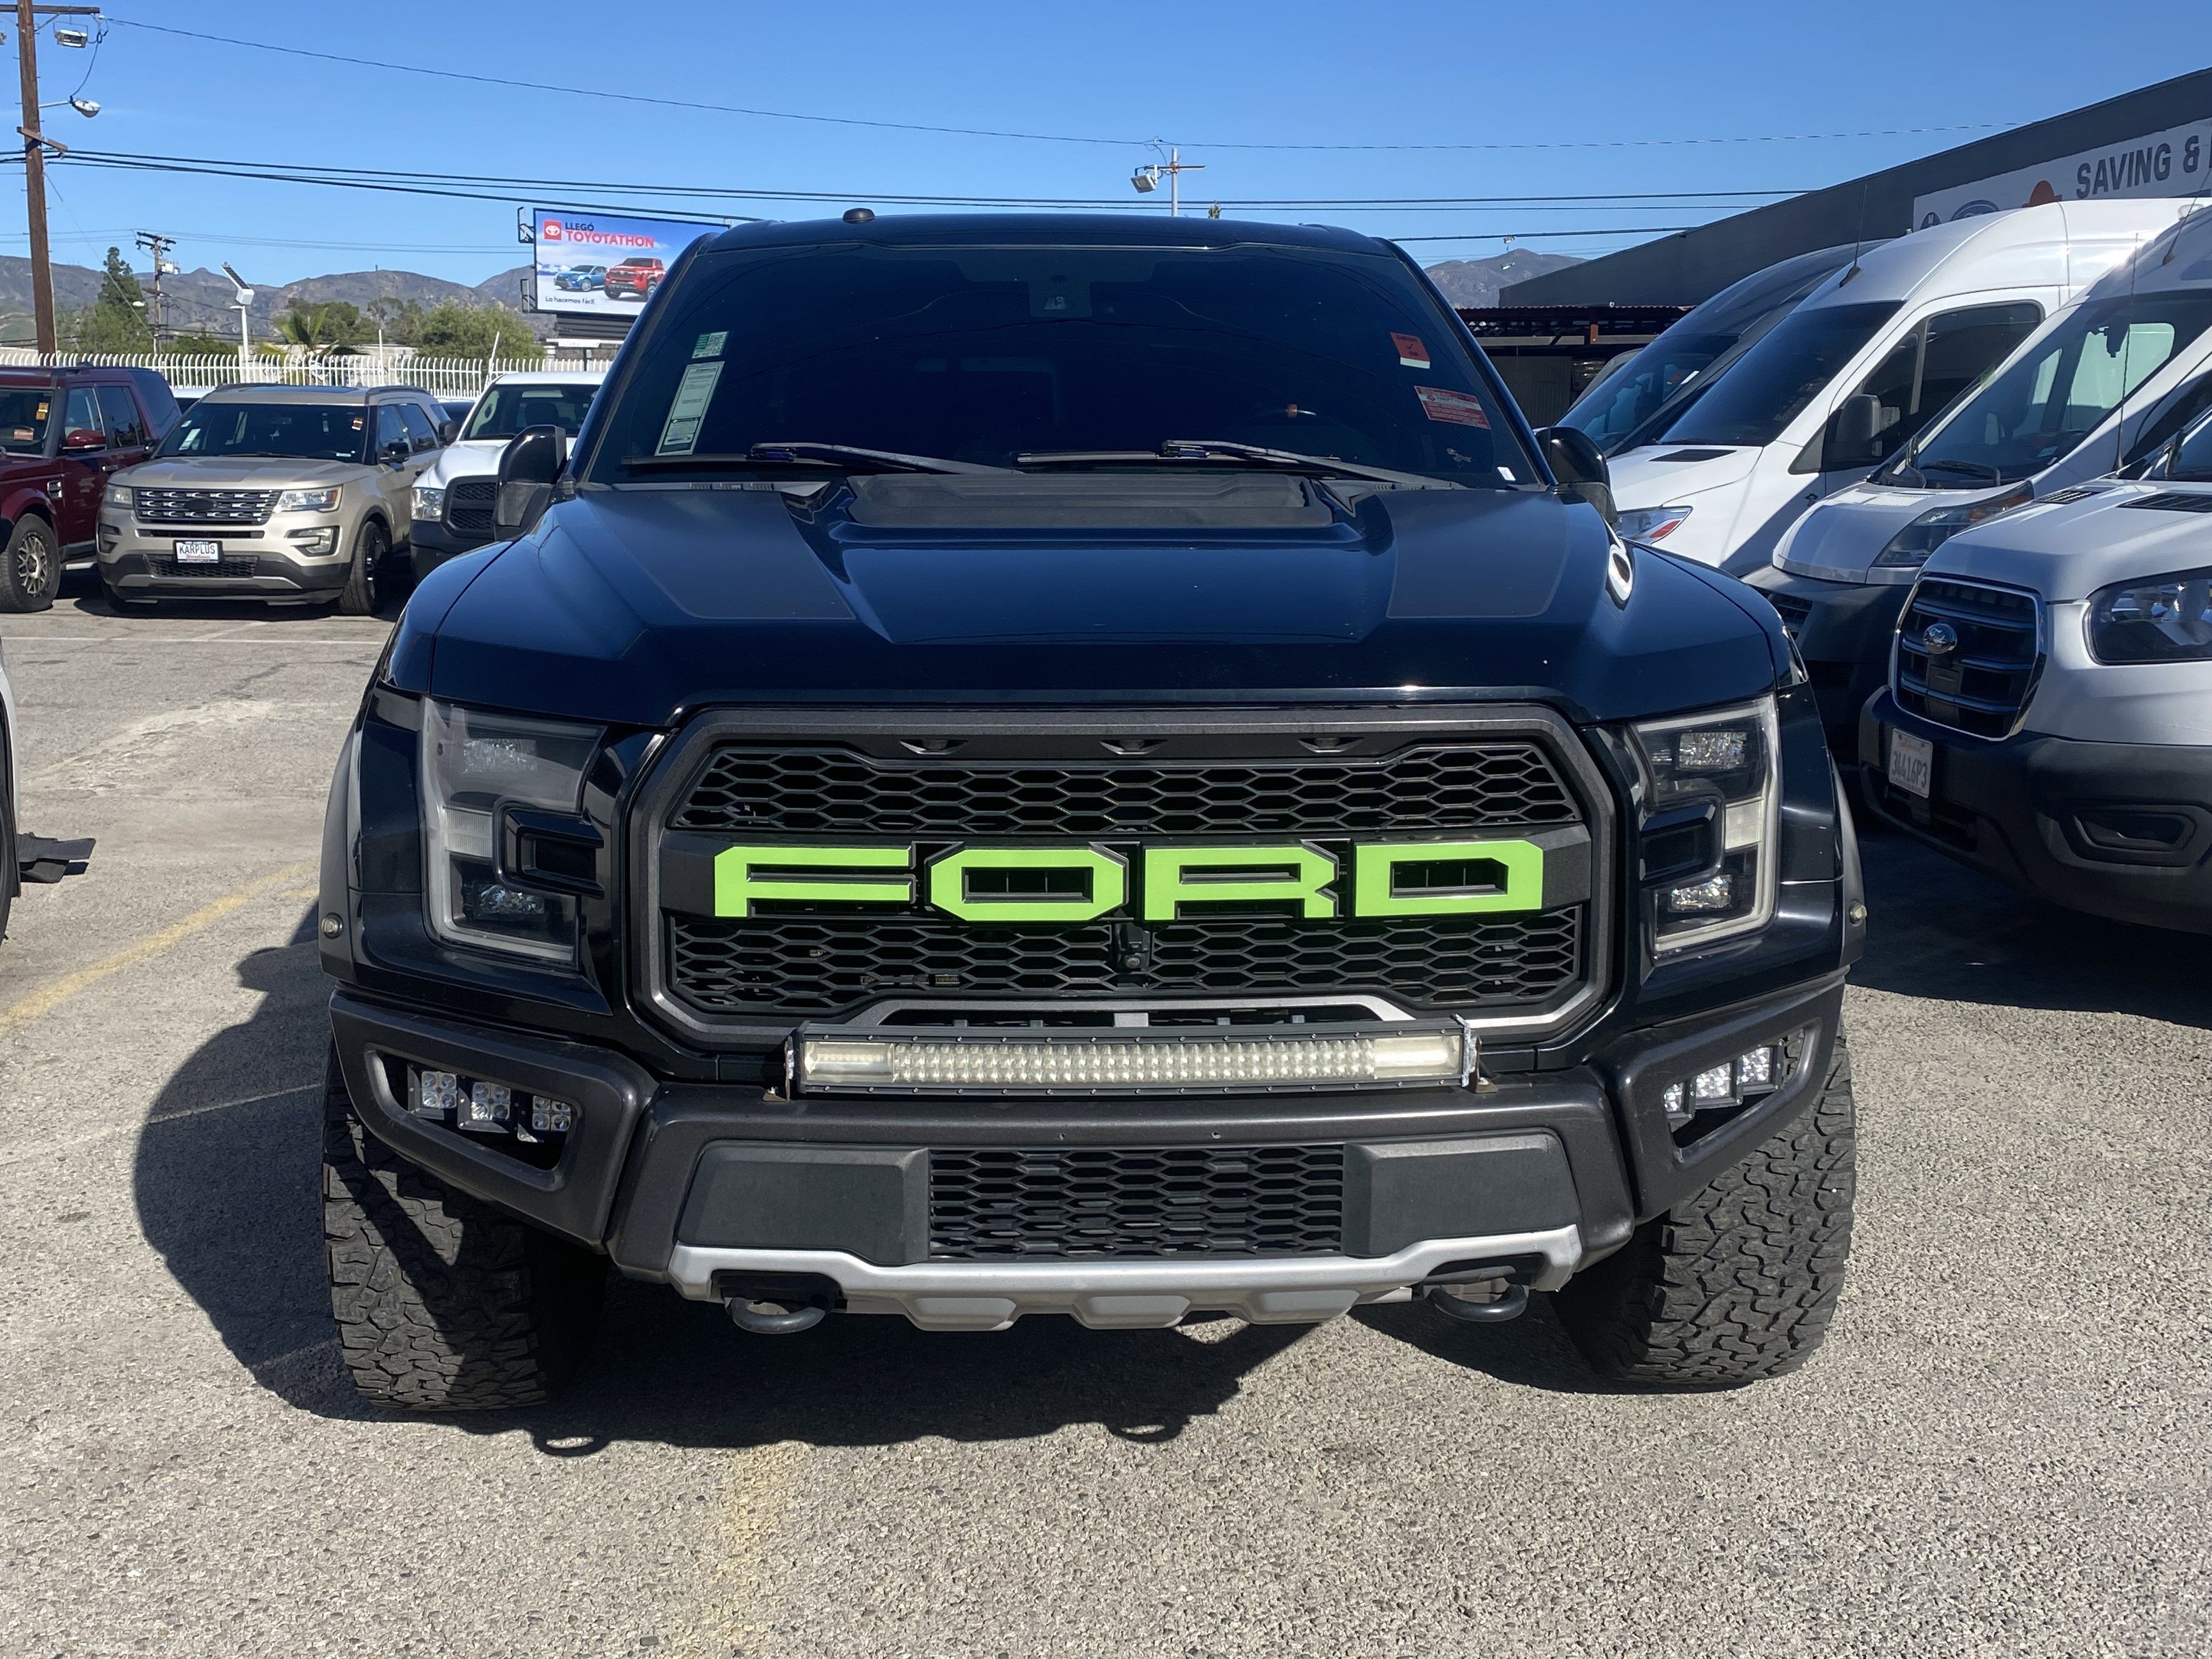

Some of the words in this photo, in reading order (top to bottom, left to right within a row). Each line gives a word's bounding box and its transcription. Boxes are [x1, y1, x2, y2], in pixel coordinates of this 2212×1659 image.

[2076, 143, 2171, 199] SAVING
[2183, 135, 2200, 173] &
[565, 221, 594, 232] LLEGÓ
[566, 231, 654, 248] TOYOTATHON
[179, 545, 216, 555] KARPLUS
[716, 840, 1541, 919] FORD
